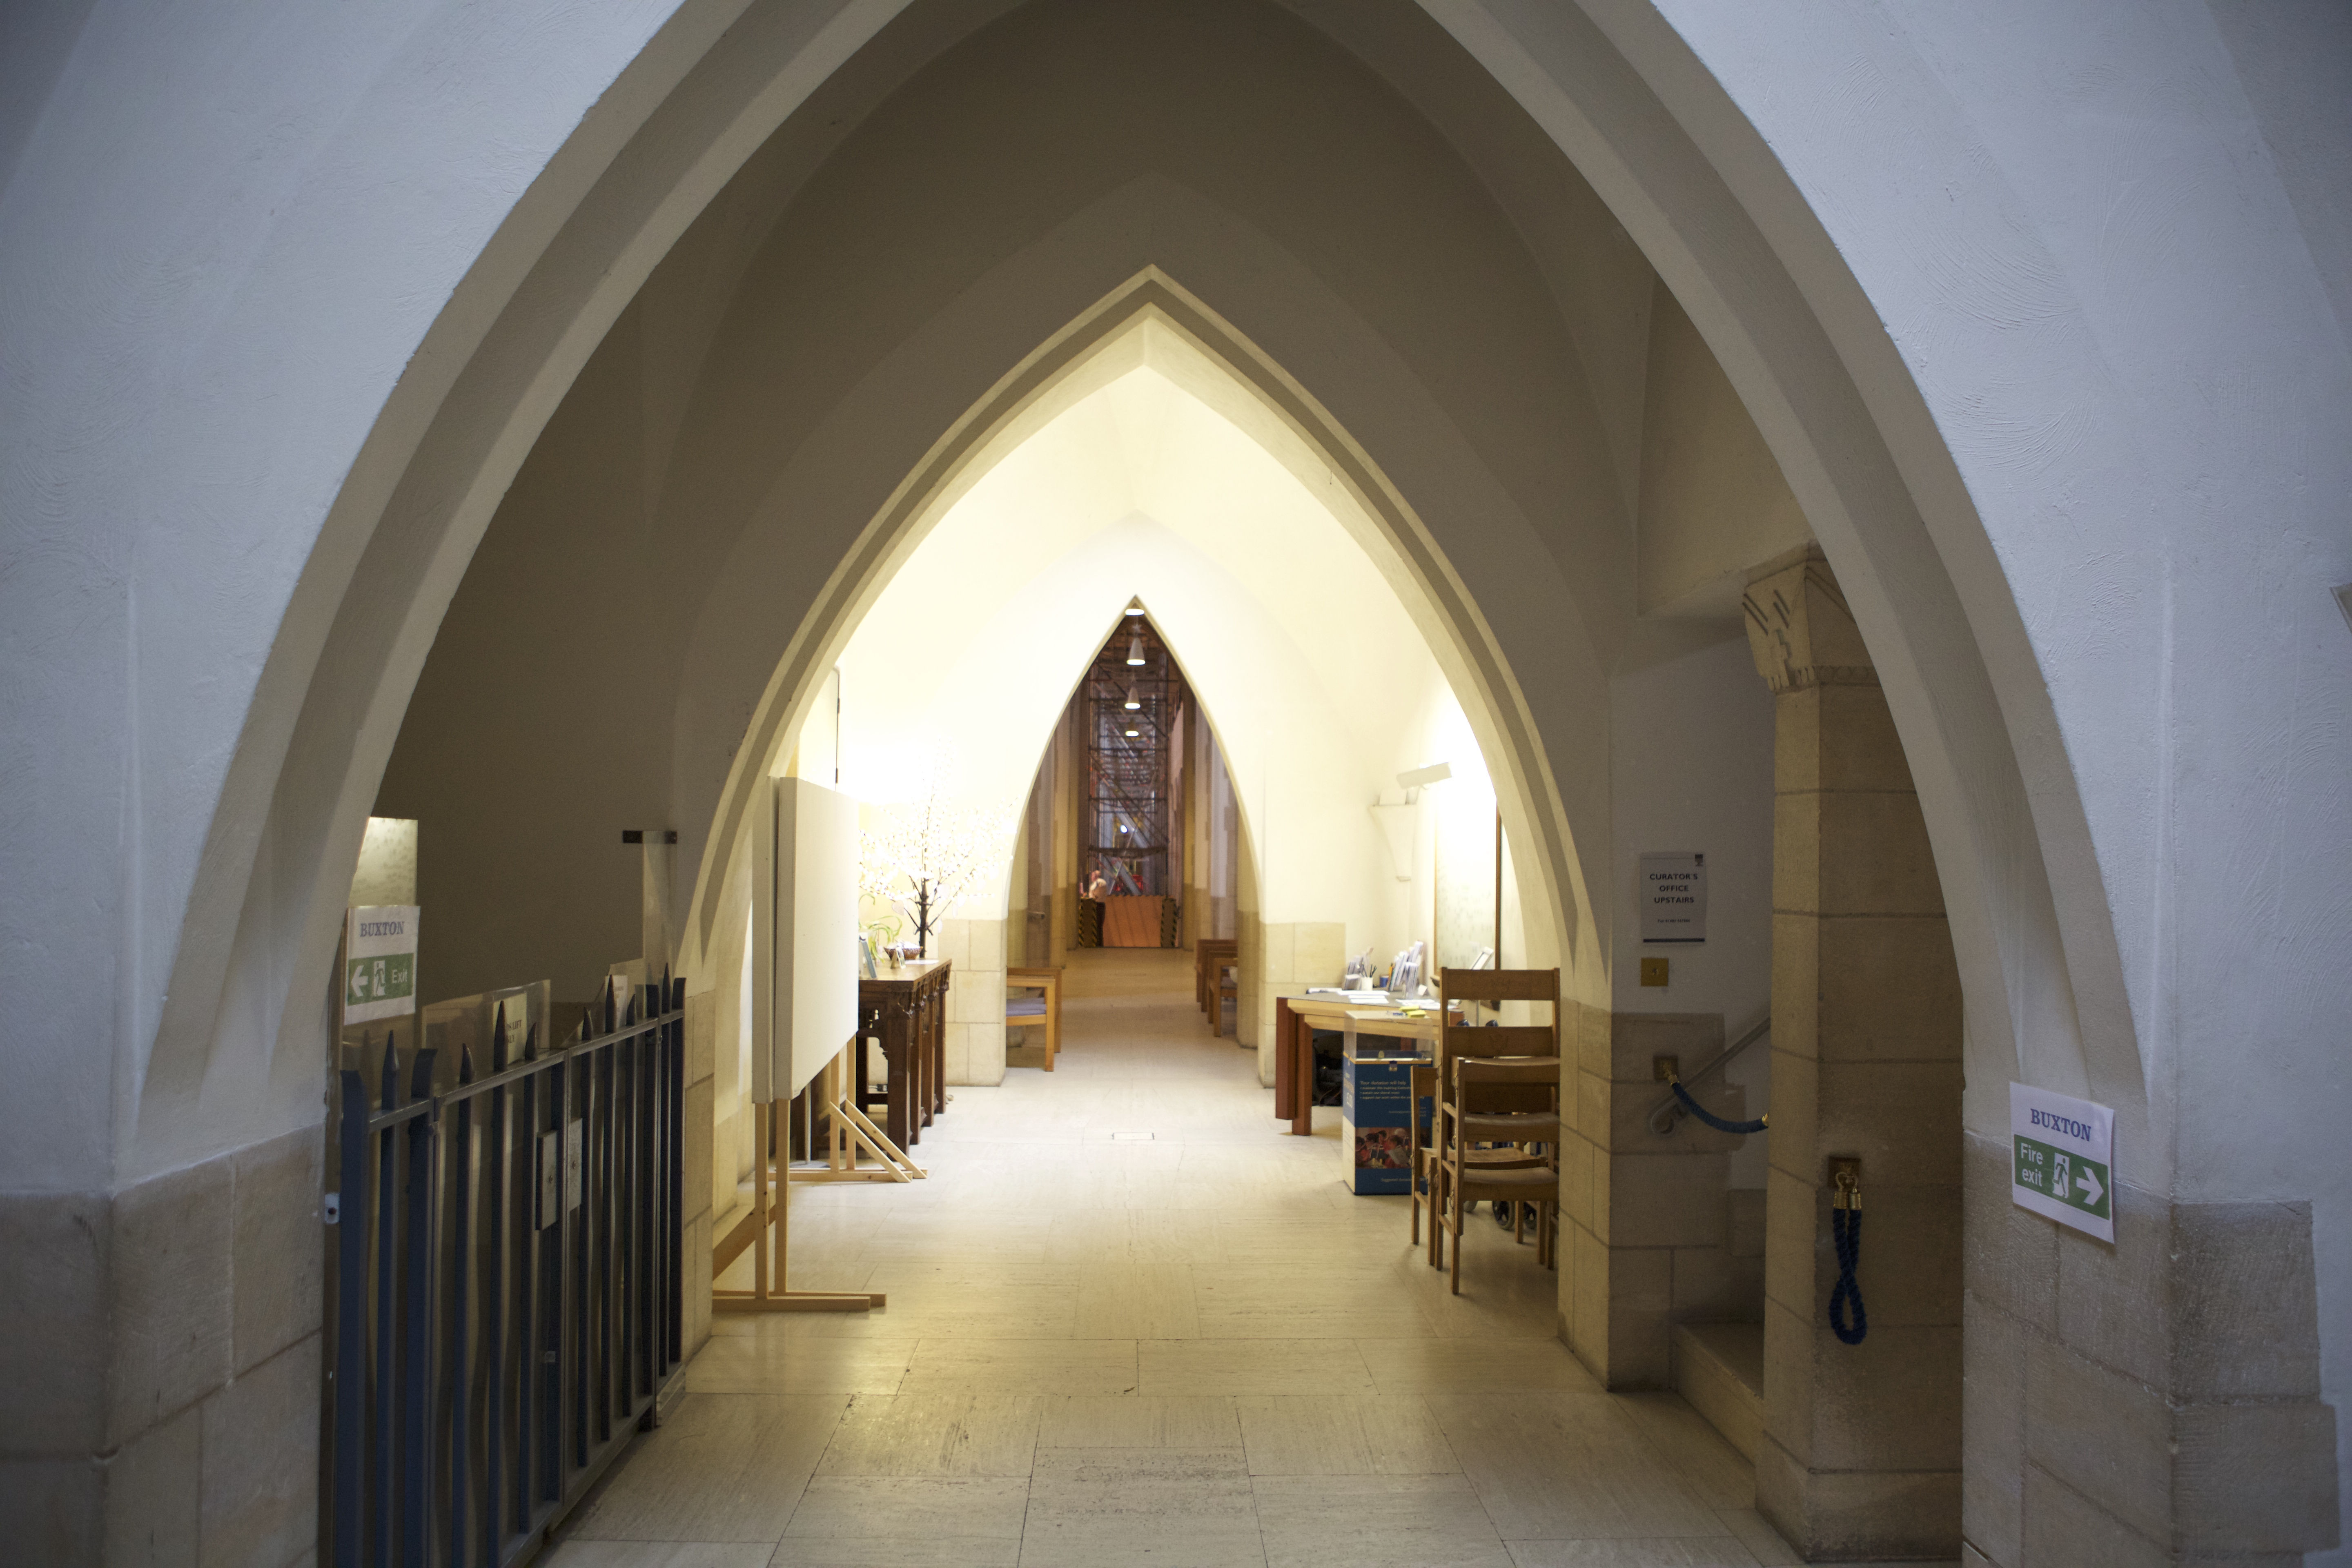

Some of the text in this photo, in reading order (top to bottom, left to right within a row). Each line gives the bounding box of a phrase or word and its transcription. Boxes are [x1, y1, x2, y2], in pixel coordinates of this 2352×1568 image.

[360, 921, 405, 938] BUXTON
[392, 969, 408, 984] Exit
[512, 1019, 522, 1030] LIFT
[2030, 1108, 2091, 1142] BUXTON
[2020, 1142, 2043, 1165] Fire
[2022, 1167, 2042, 1187] exit
